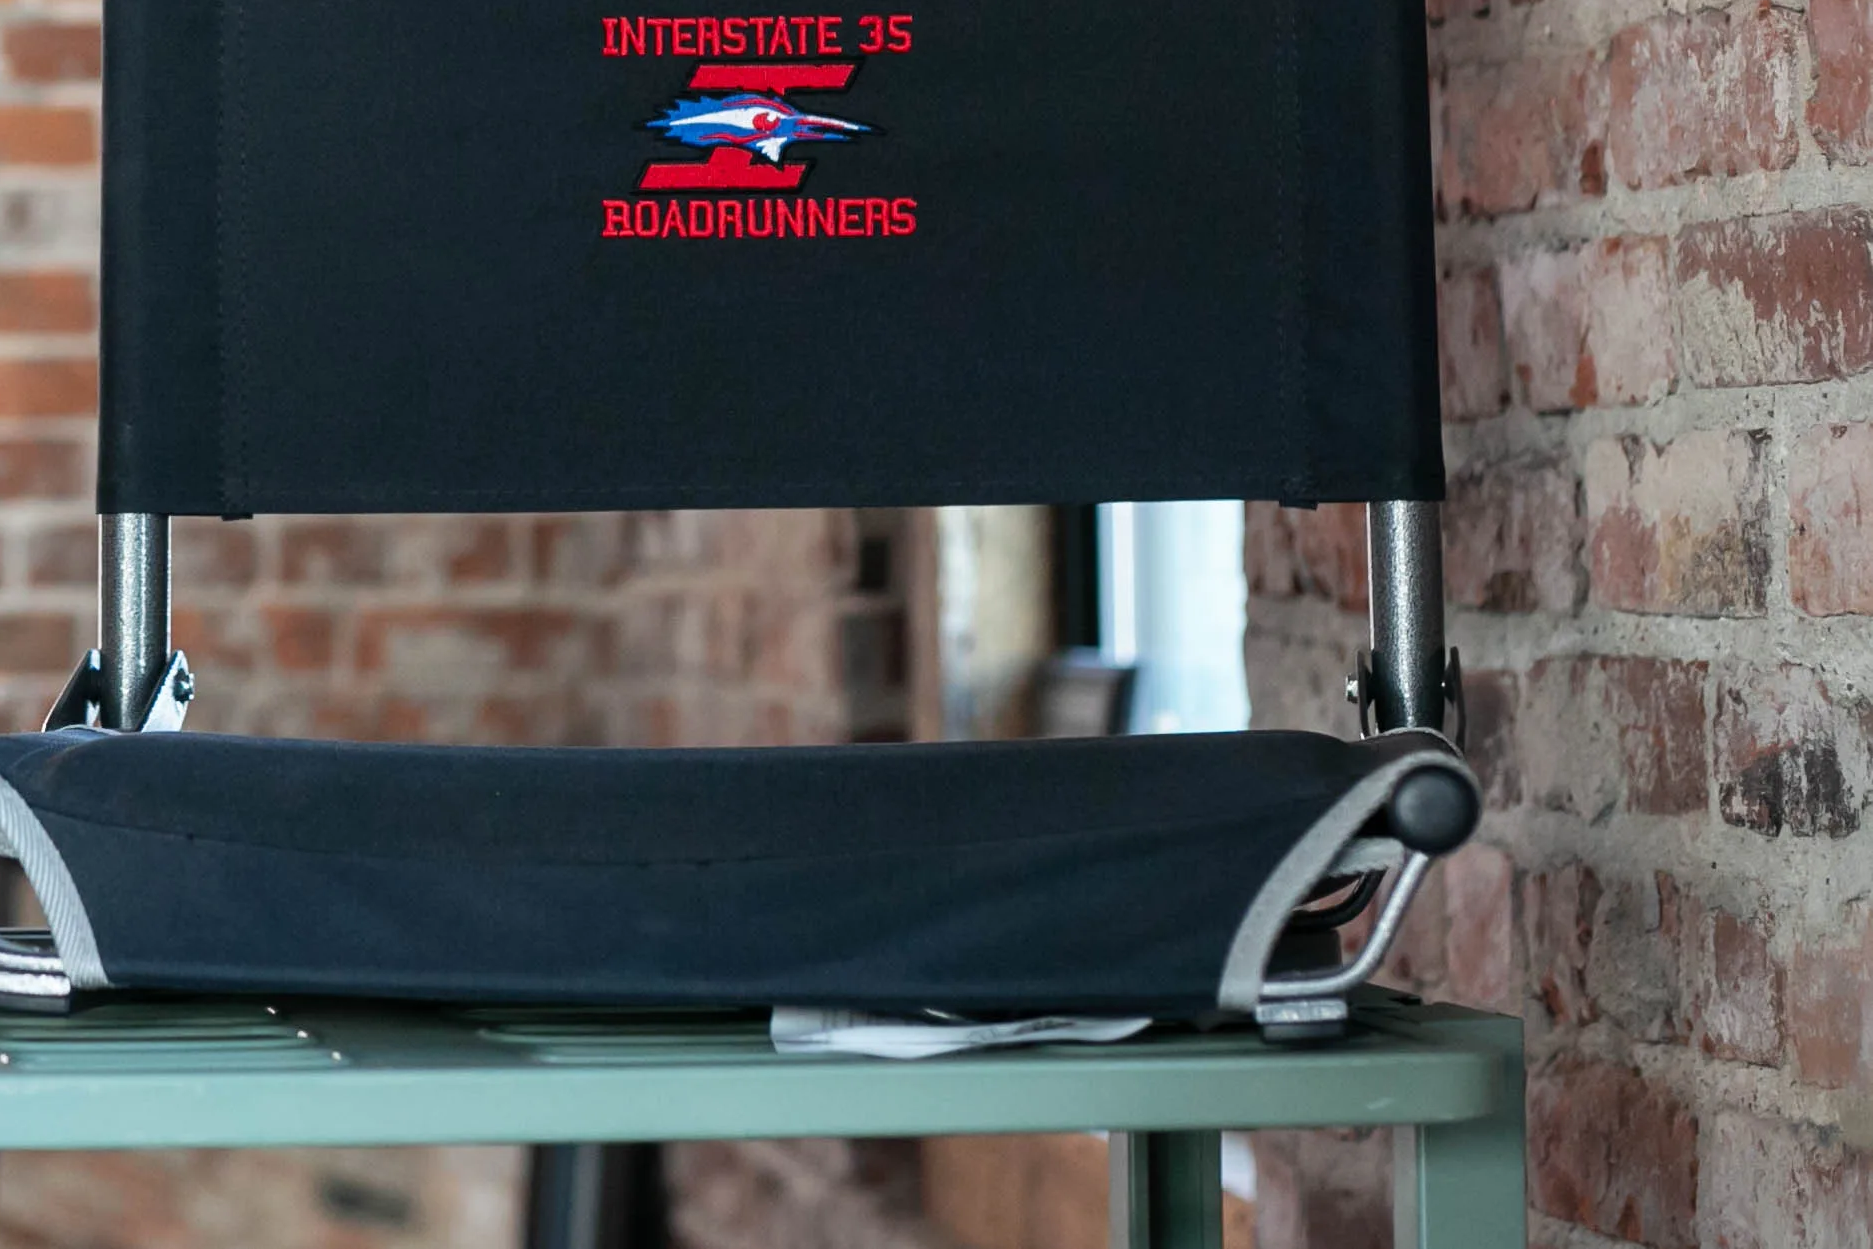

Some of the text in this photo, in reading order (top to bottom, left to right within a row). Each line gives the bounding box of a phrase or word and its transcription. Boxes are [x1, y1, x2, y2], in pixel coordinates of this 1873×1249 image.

[601, 15, 914, 56] INTERSTATE 35
[601, 197, 918, 239] ROADRUNNERS
